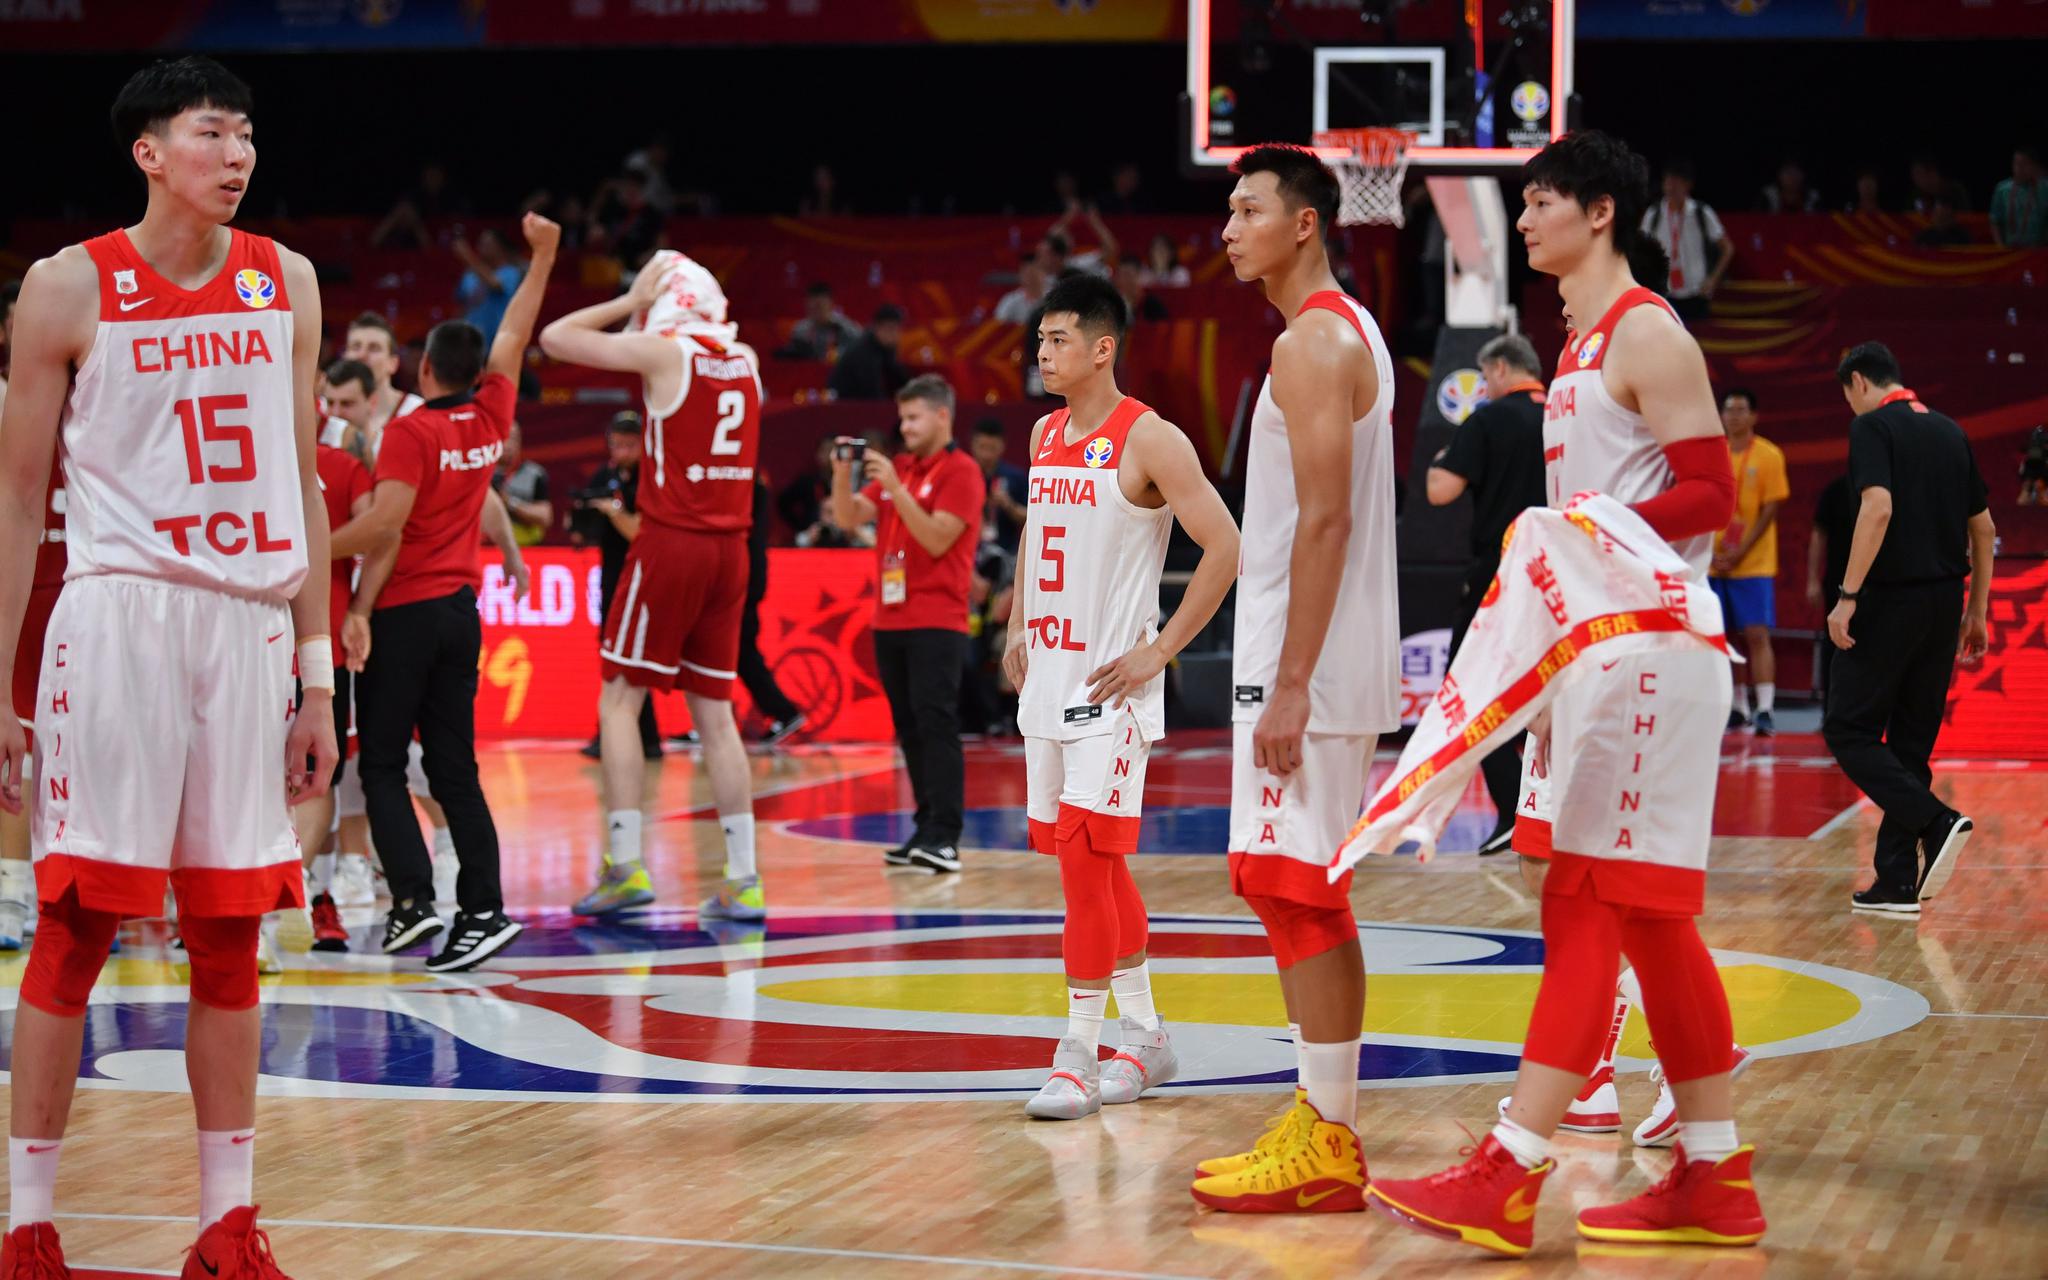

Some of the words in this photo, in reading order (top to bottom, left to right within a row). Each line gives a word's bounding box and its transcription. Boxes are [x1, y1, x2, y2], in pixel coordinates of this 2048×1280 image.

[132, 330, 273, 373] CHINA
[174, 394, 257, 485] 15
[711, 390, 745, 455] 2
[1030, 478, 1096, 507] CHINA
[154, 511, 292, 557] TCL
[1039, 526, 1066, 592] 5
[1028, 615, 1086, 651] TCL
[1615, 672, 1657, 849] CHINA
